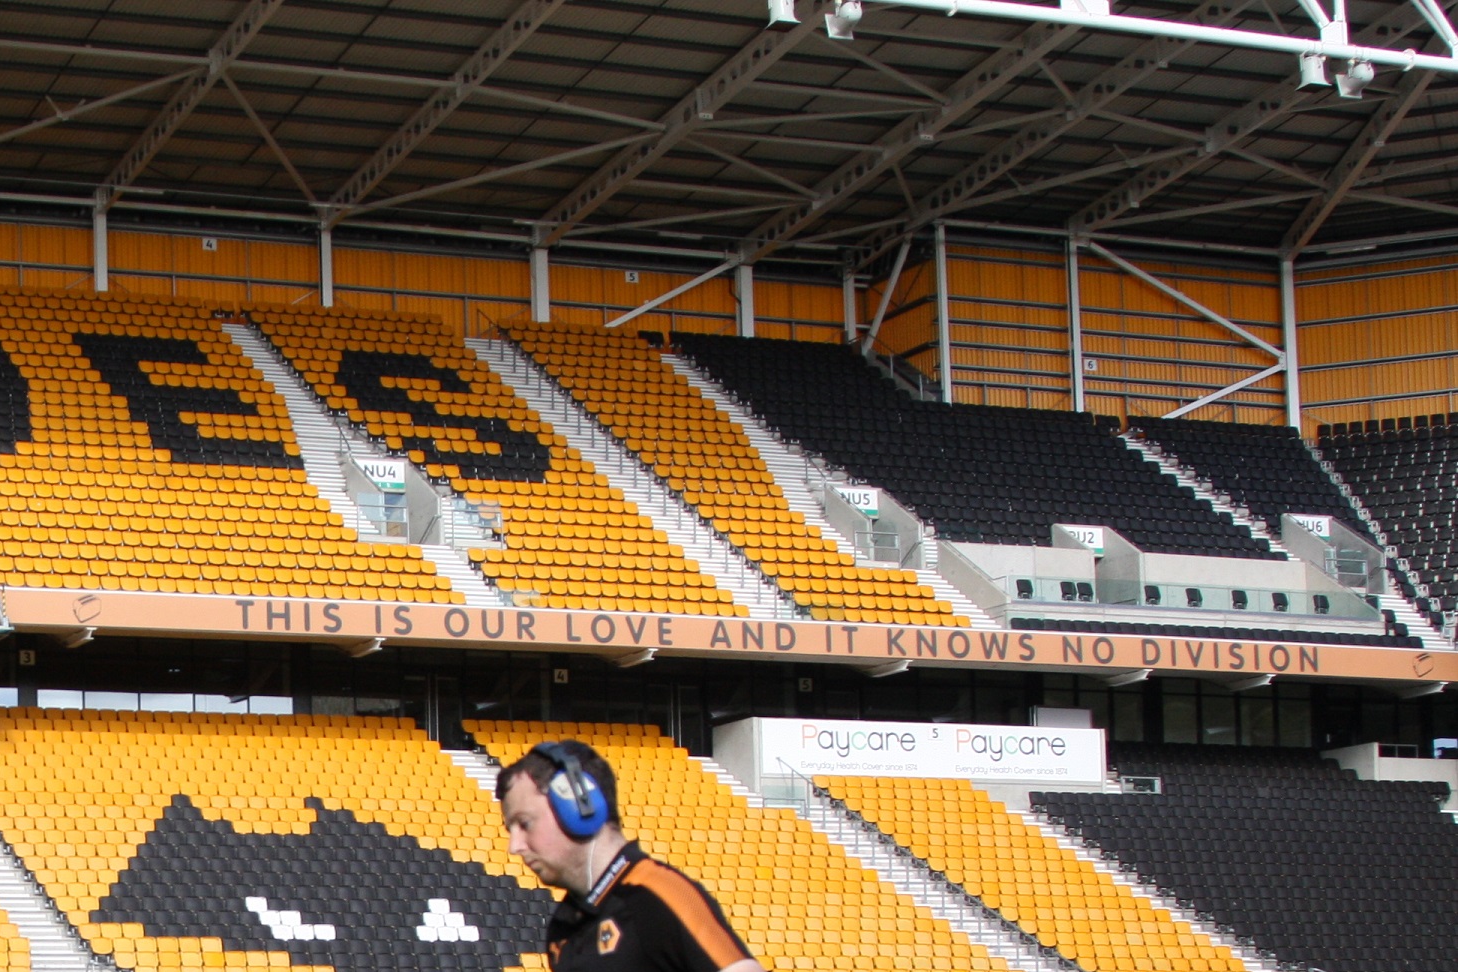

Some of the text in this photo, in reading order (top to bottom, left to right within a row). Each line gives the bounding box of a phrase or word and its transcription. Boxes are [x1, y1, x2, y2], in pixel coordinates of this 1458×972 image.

[205, 239, 213, 248] 4
[629, 272, 636, 282] 5
[1087, 360, 1094, 369] 6
[364, 465, 397, 478] NU4
[234, 599, 1320, 673] THIS IS OUR LOVE AND IT KNOWS NO DIVISION
[23, 652, 31, 663] 3
[557, 669, 564, 681] 4
[802, 679, 809, 689] 5
[932, 728, 939, 738] 5
[801, 724, 917, 757] Paycare
[956, 728, 1066, 761] Paycare
